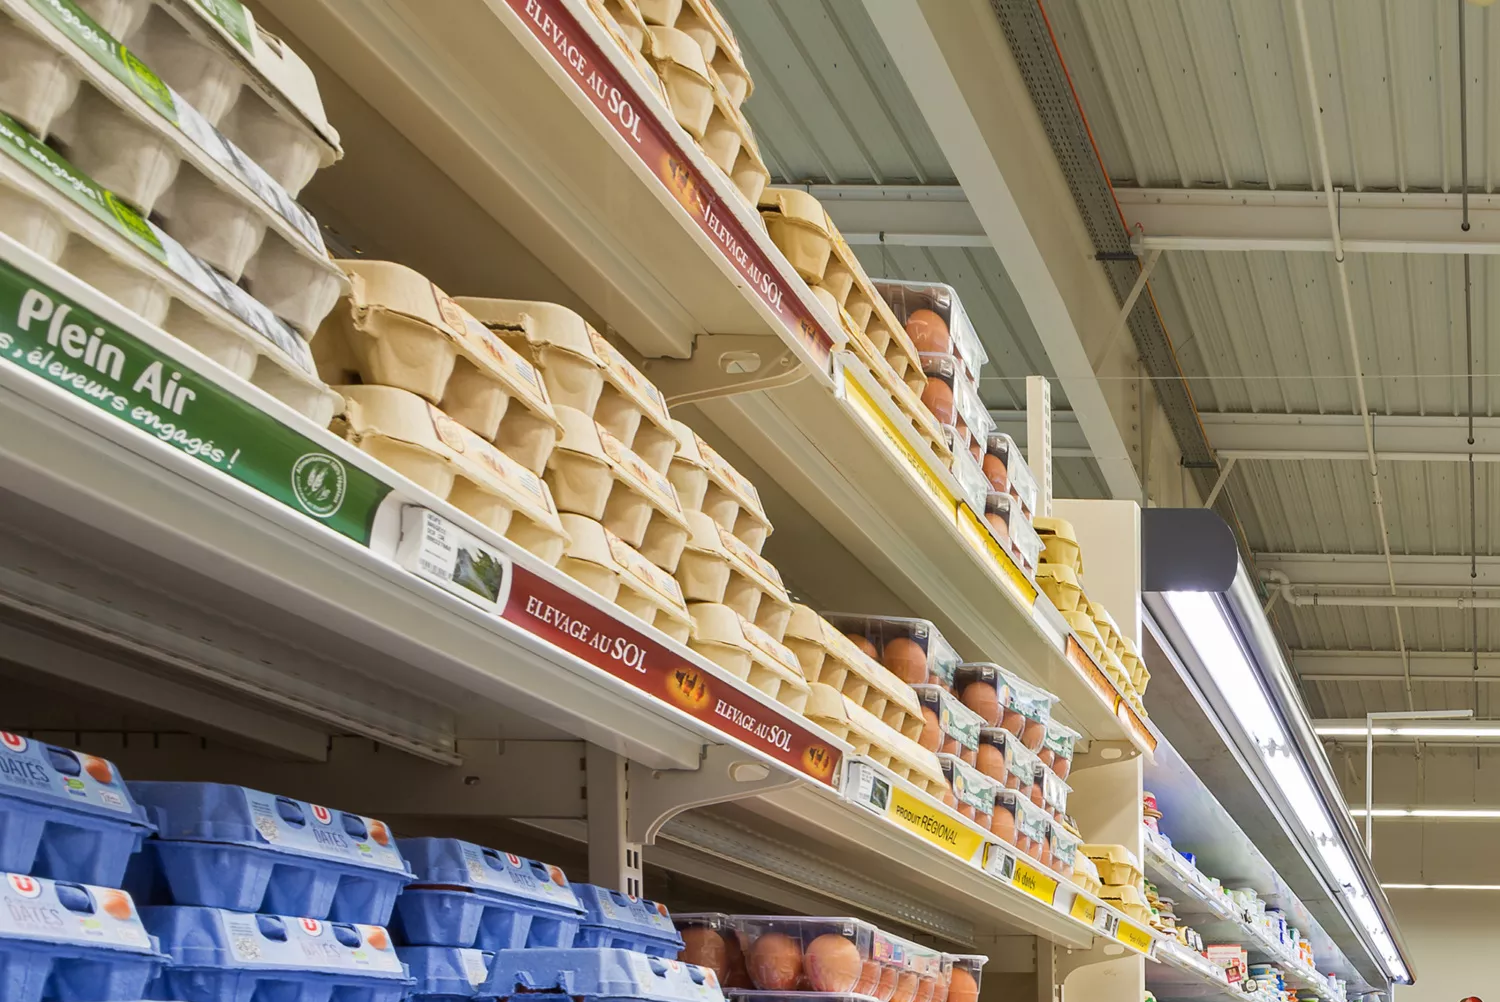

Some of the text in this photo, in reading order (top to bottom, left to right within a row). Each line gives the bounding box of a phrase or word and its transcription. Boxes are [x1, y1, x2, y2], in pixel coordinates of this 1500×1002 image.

[525, 0, 641, 143] ELEVAGE AU SOL
[708, 211, 782, 314] ELEVAGE AU SOL
[17, 288, 196, 416] Plein Air
[27, 346, 129, 411] éleveurs
[131, 406, 225, 463] engagés
[525, 595, 647, 674] ELEVAGE AU SOL
[714, 698, 791, 752] ELEVAGE AU SOL
[896, 805, 958, 846] PRODUIT RÉGIONAL
